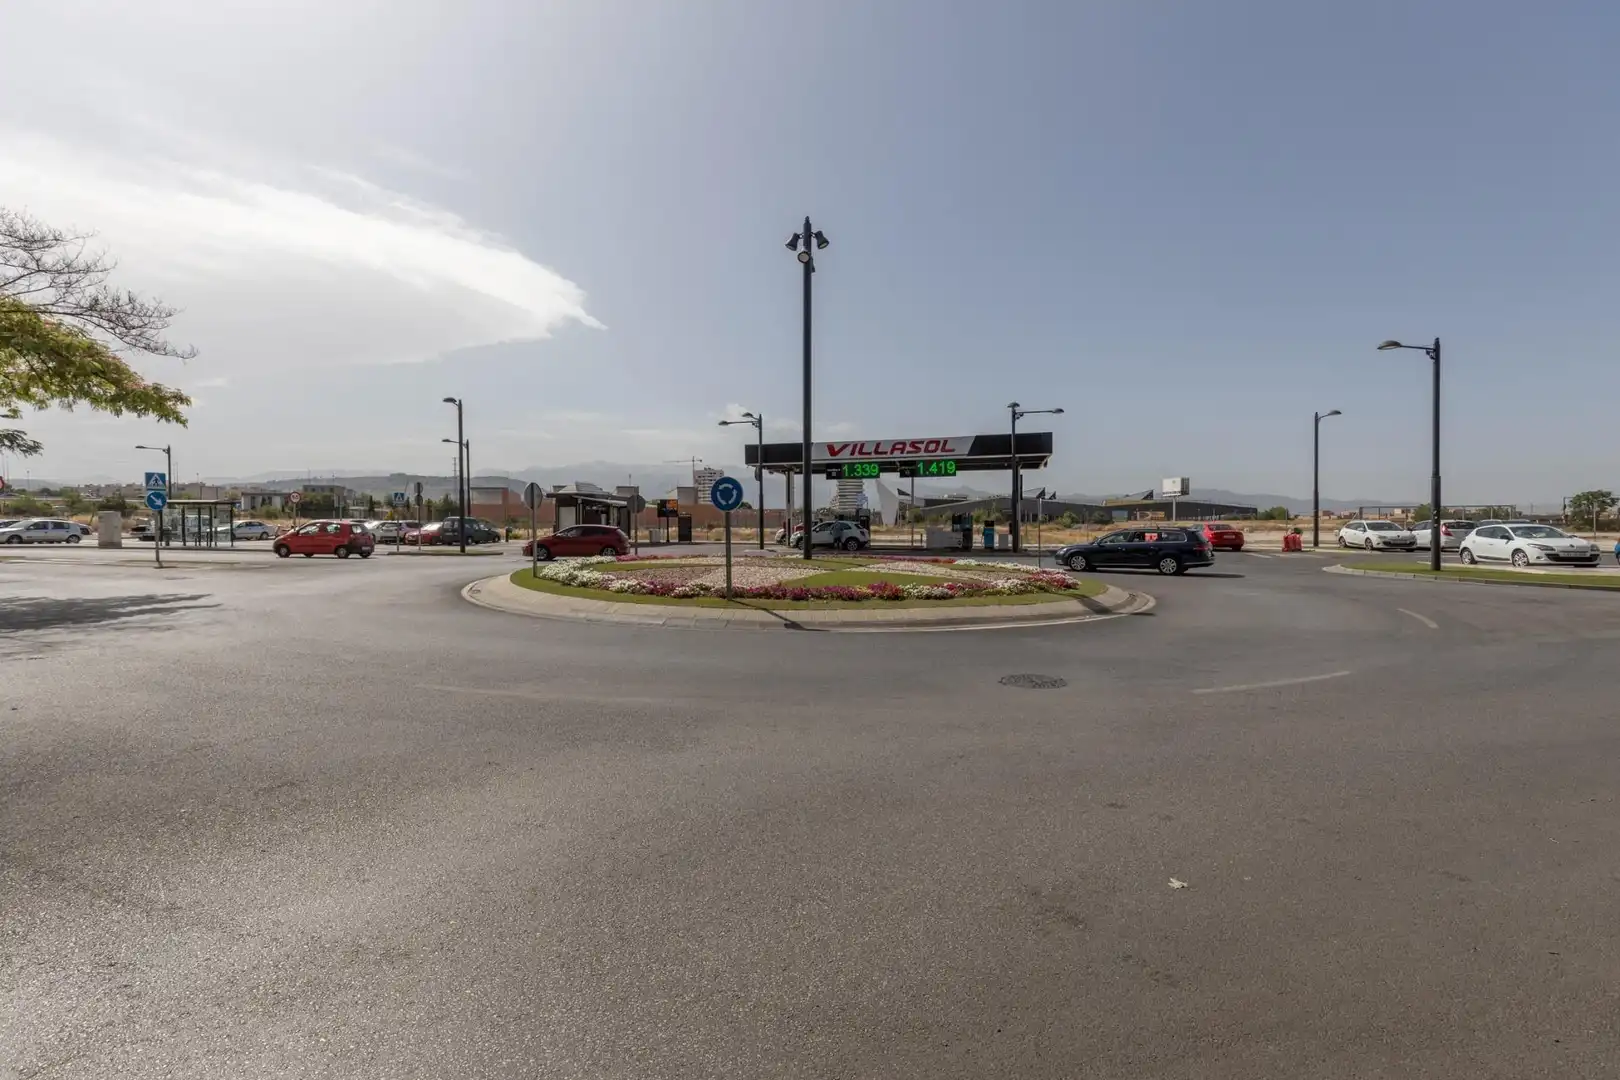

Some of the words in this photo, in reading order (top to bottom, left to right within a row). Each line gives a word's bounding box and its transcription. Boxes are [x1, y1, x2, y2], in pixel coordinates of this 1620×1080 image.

[826, 439, 956, 457] VILLASOL
[842, 463, 880, 477] 1.339
[917, 460, 956, 475] 1.419
